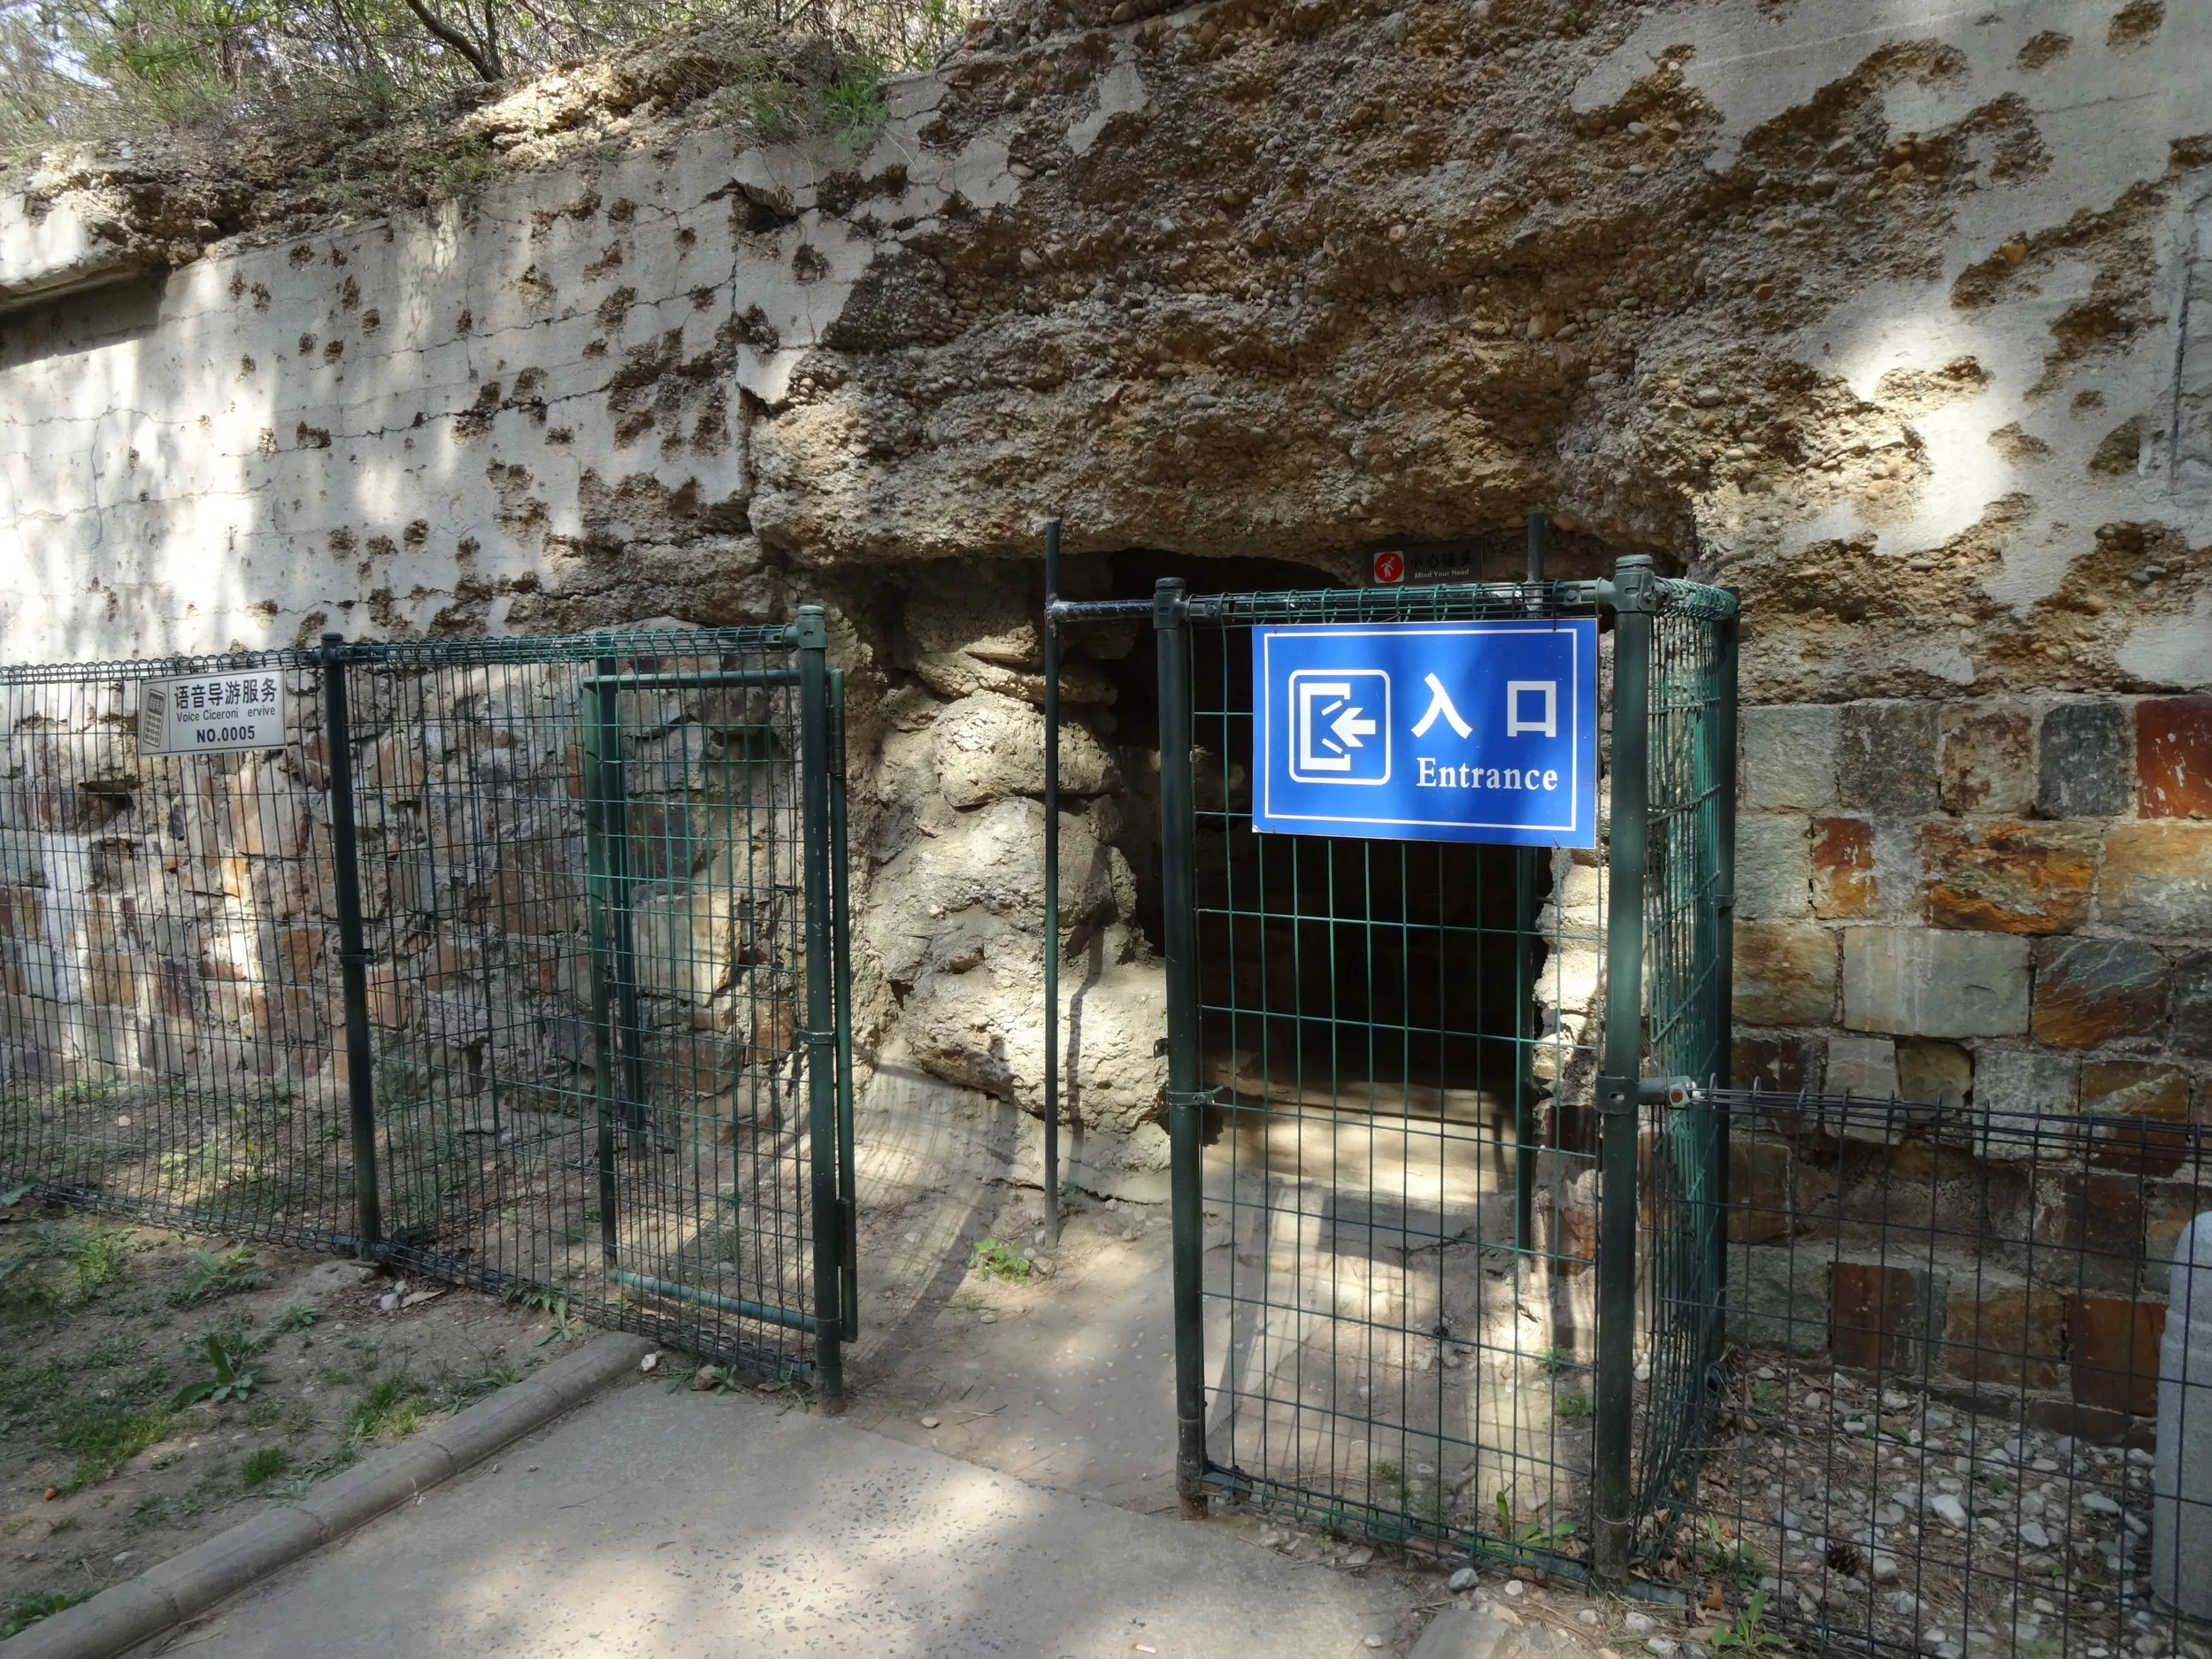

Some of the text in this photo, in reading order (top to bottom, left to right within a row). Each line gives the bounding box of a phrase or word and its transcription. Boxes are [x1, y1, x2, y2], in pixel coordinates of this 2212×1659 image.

[174, 678, 277, 709] 语音导游服务
[1410, 672, 1556, 739] 入口
[177, 711, 200, 723] Voice
[203, 708, 239, 721] Ciceroni
[196, 726, 255, 743] NO.0005
[1416, 757, 1558, 791] Entrance
